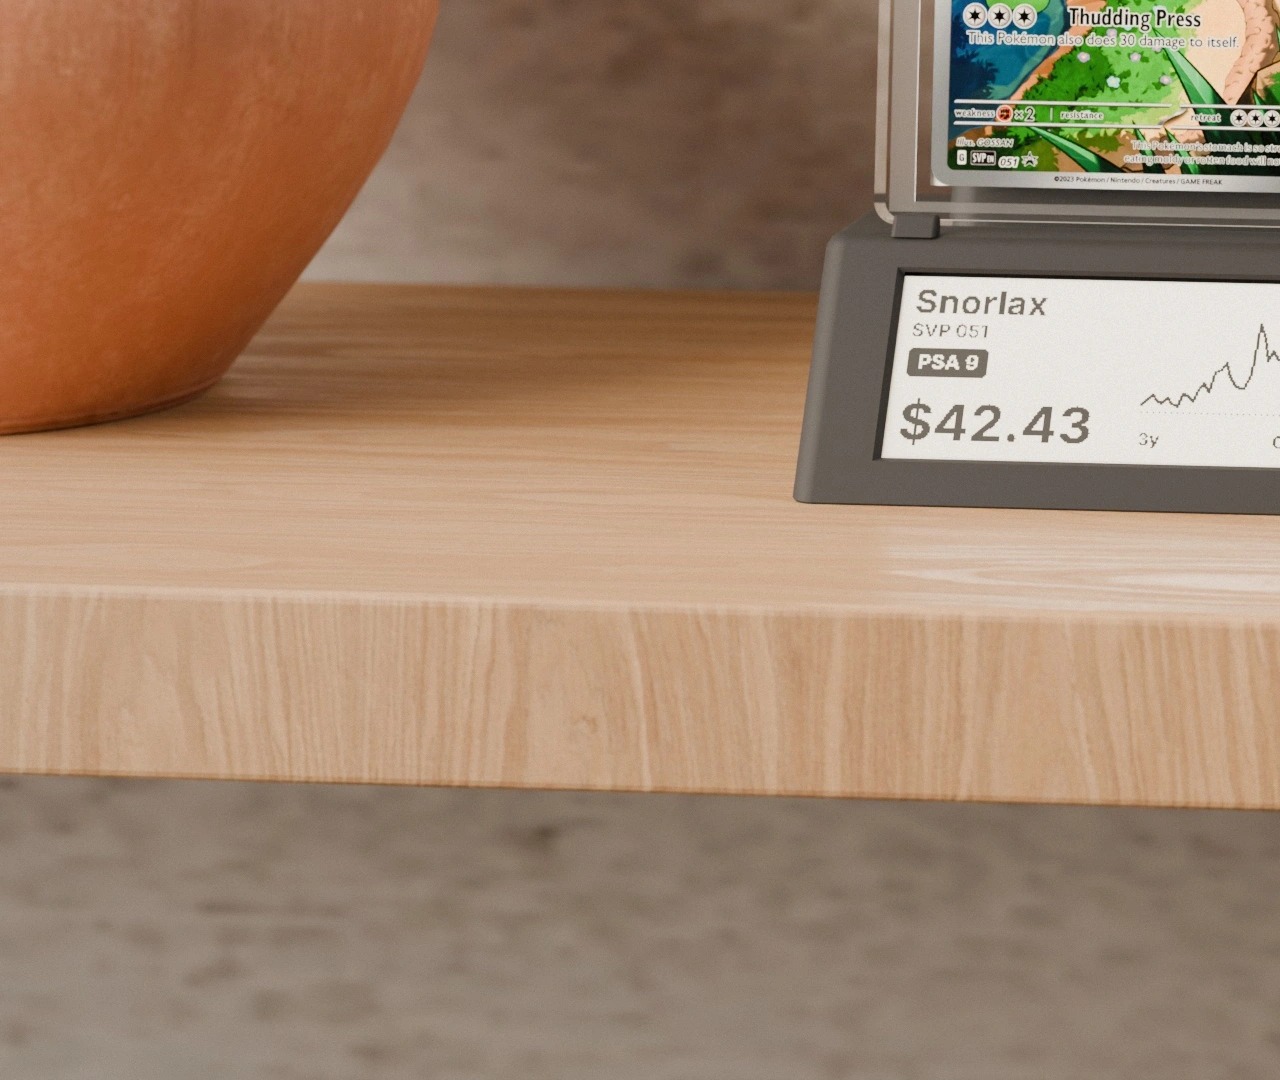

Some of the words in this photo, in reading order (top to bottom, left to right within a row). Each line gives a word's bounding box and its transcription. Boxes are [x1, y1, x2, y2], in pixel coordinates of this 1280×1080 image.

[1069, 7, 1150, 30] Thudding
[1156, 9, 1201, 28] Press
[966, 31, 994, 44] This
[998, 31, 1054, 46] Pokémon
[1057, 33, 1083, 46] also
[1086, 34, 1116, 46] does
[1120, 35, 1135, 46] 30
[1139, 36, 1185, 50] damage
[1189, 37, 1203, 48] to
[1207, 36, 1240, 48] itself.
[916, 289, 1048, 317] Snorlax
[913, 322, 952, 338] SVP
[956, 324, 989, 339] 051
[917, 354, 961, 370] PSA
[965, 355, 980, 371] 9
[899, 397, 1091, 445] $42.43
[1138, 432, 1159, 448] 3y
